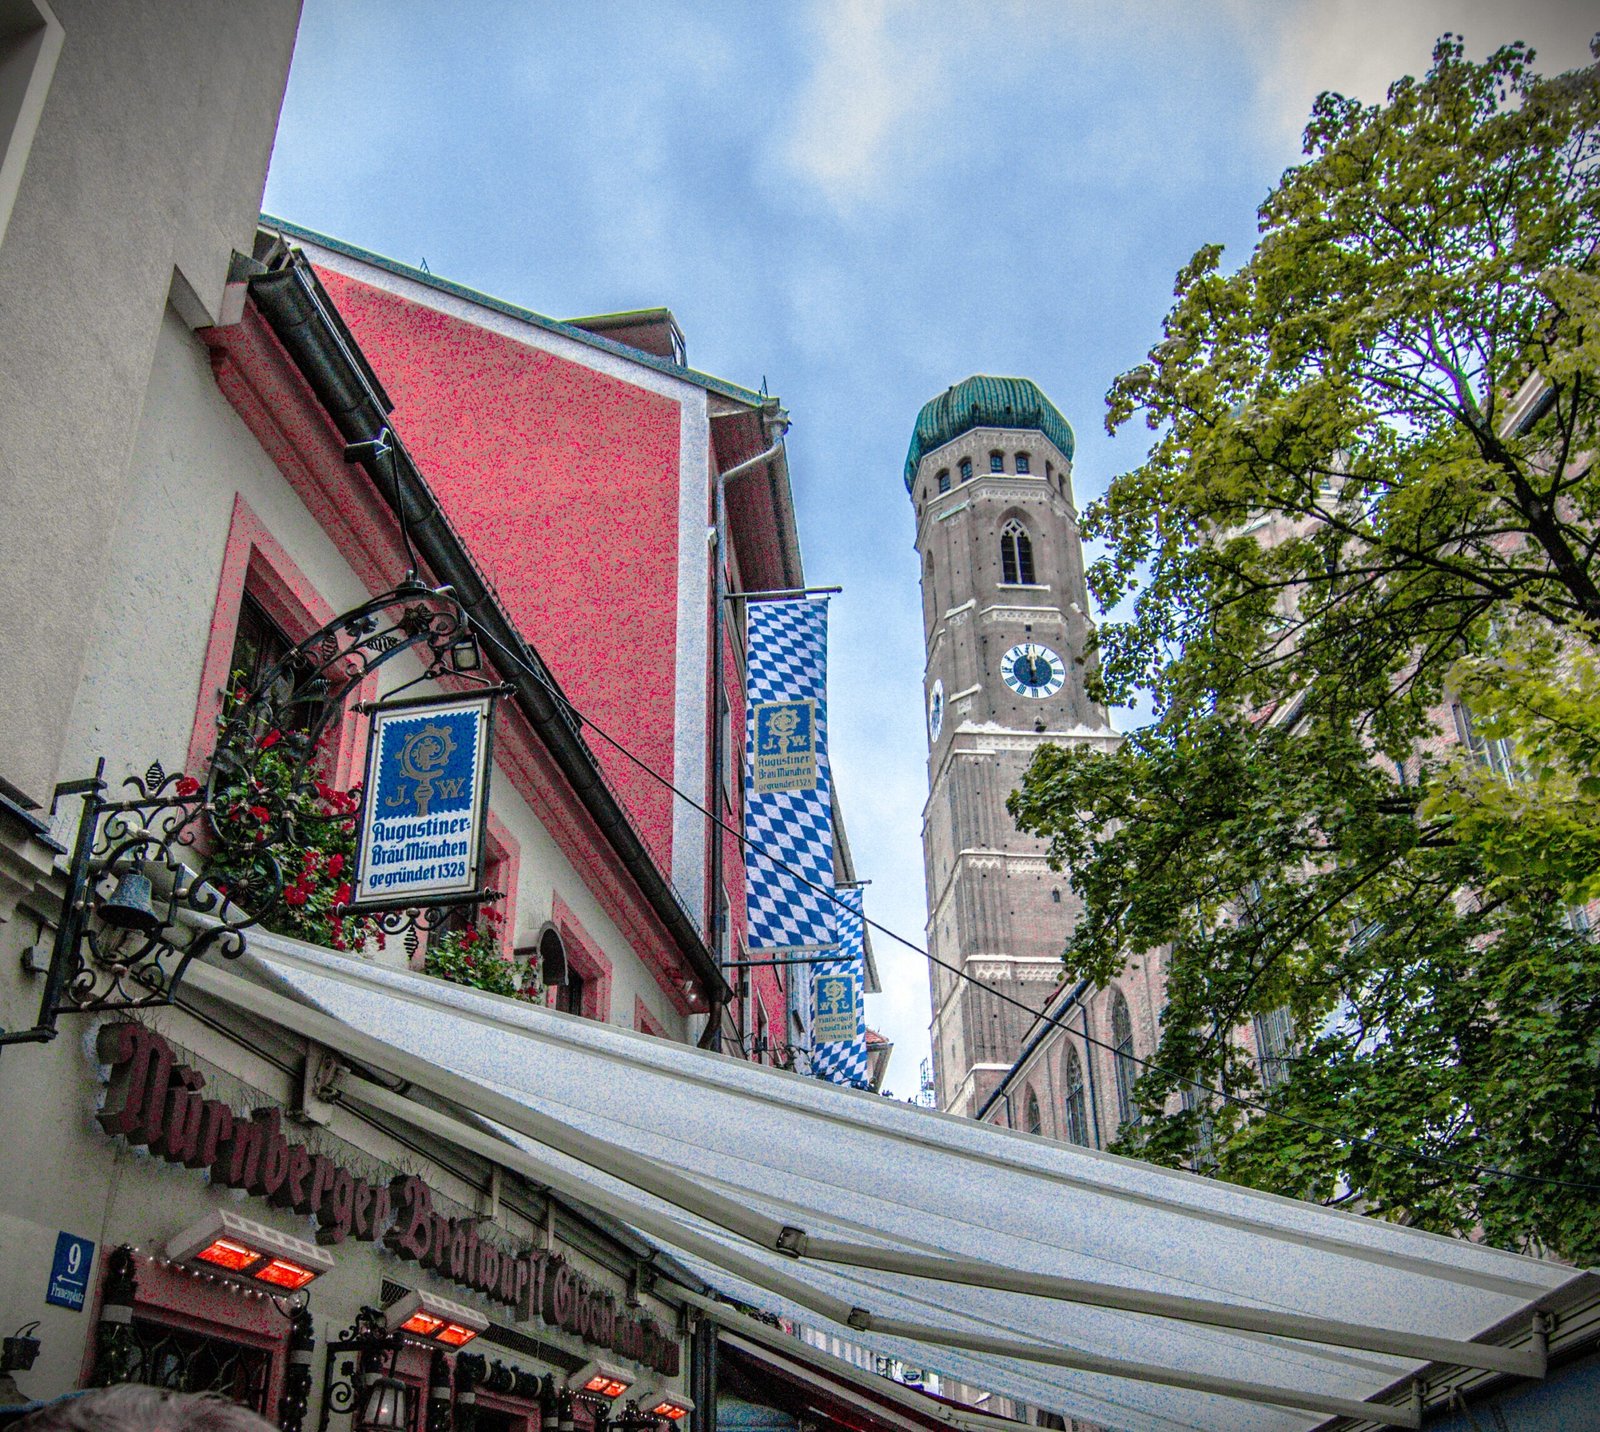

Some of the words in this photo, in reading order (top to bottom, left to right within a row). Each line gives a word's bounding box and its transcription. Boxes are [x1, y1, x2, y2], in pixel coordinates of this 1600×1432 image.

[385, 785, 410, 807] J.
[436, 778, 465, 800] W.
[371, 844, 405, 866] Bräu
[405, 839, 468, 863] München
[369, 864, 436, 888] gegründet
[438, 862, 465, 878] 1328
[99, 1021, 391, 1246] Nürnberger
[67, 1243, 82, 1274] 9
